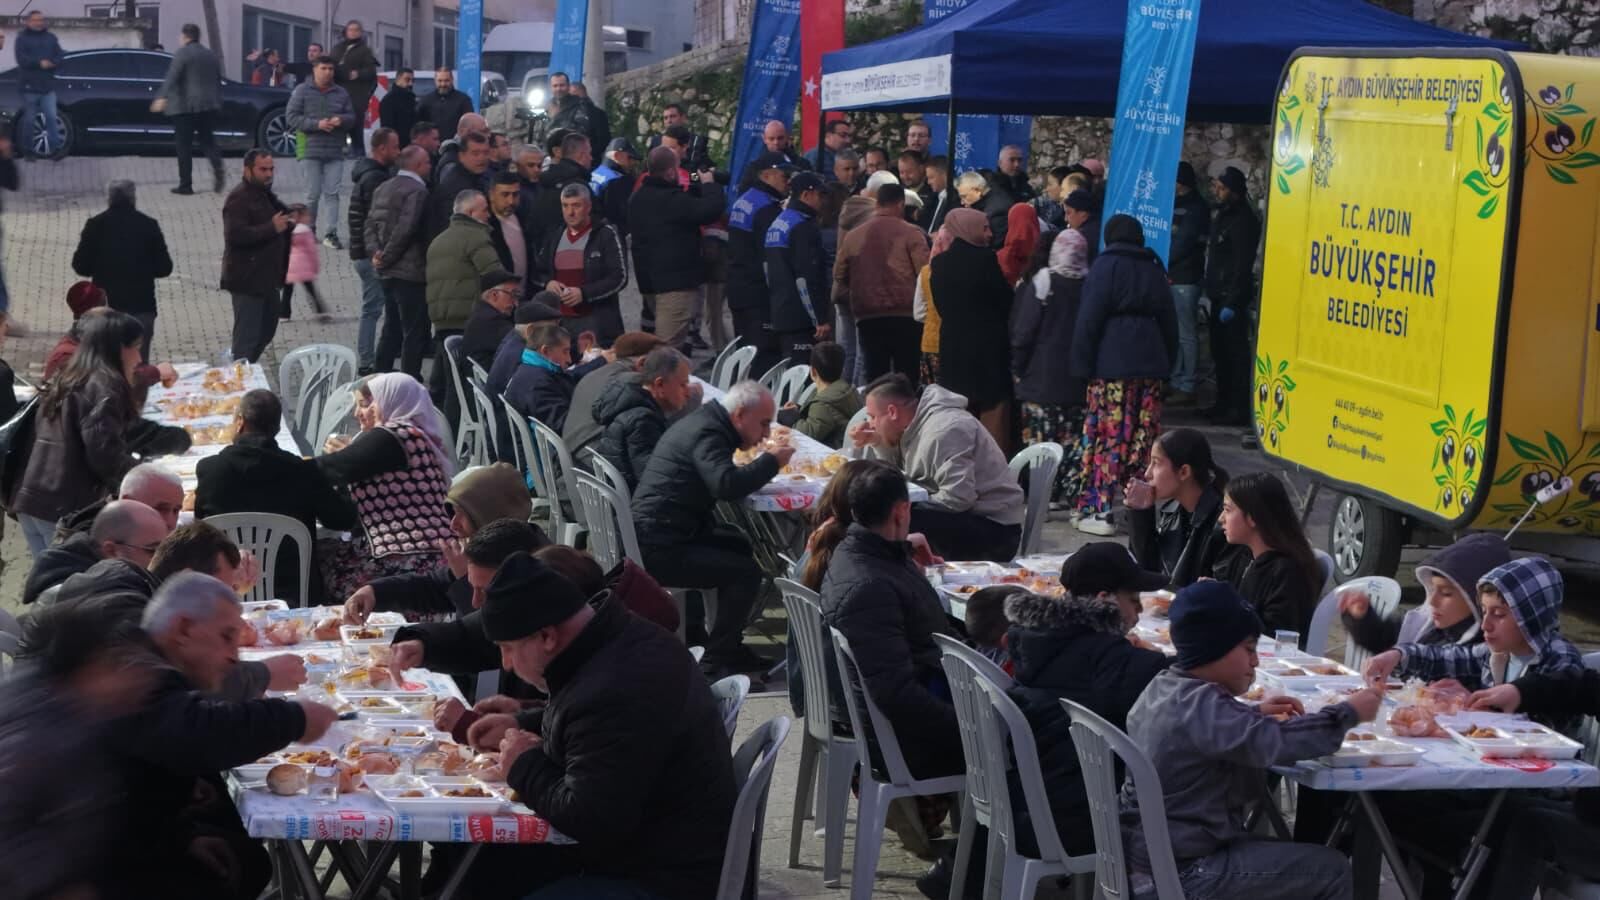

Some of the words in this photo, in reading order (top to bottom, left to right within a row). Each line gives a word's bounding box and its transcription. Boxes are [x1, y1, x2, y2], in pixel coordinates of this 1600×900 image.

[1337, 77, 1363, 98] AYDIN
[1365, 73, 1422, 106] BÜYÜKŞEHİR
[1425, 74, 1483, 103] BELEDİYESİ
[1341, 203, 1362, 230] T.C.
[1367, 207, 1411, 237] AYDIN
[1310, 234, 1436, 298] BÜYÜKŞEHİR
[1327, 297, 1408, 338] BELEDİYESİ
